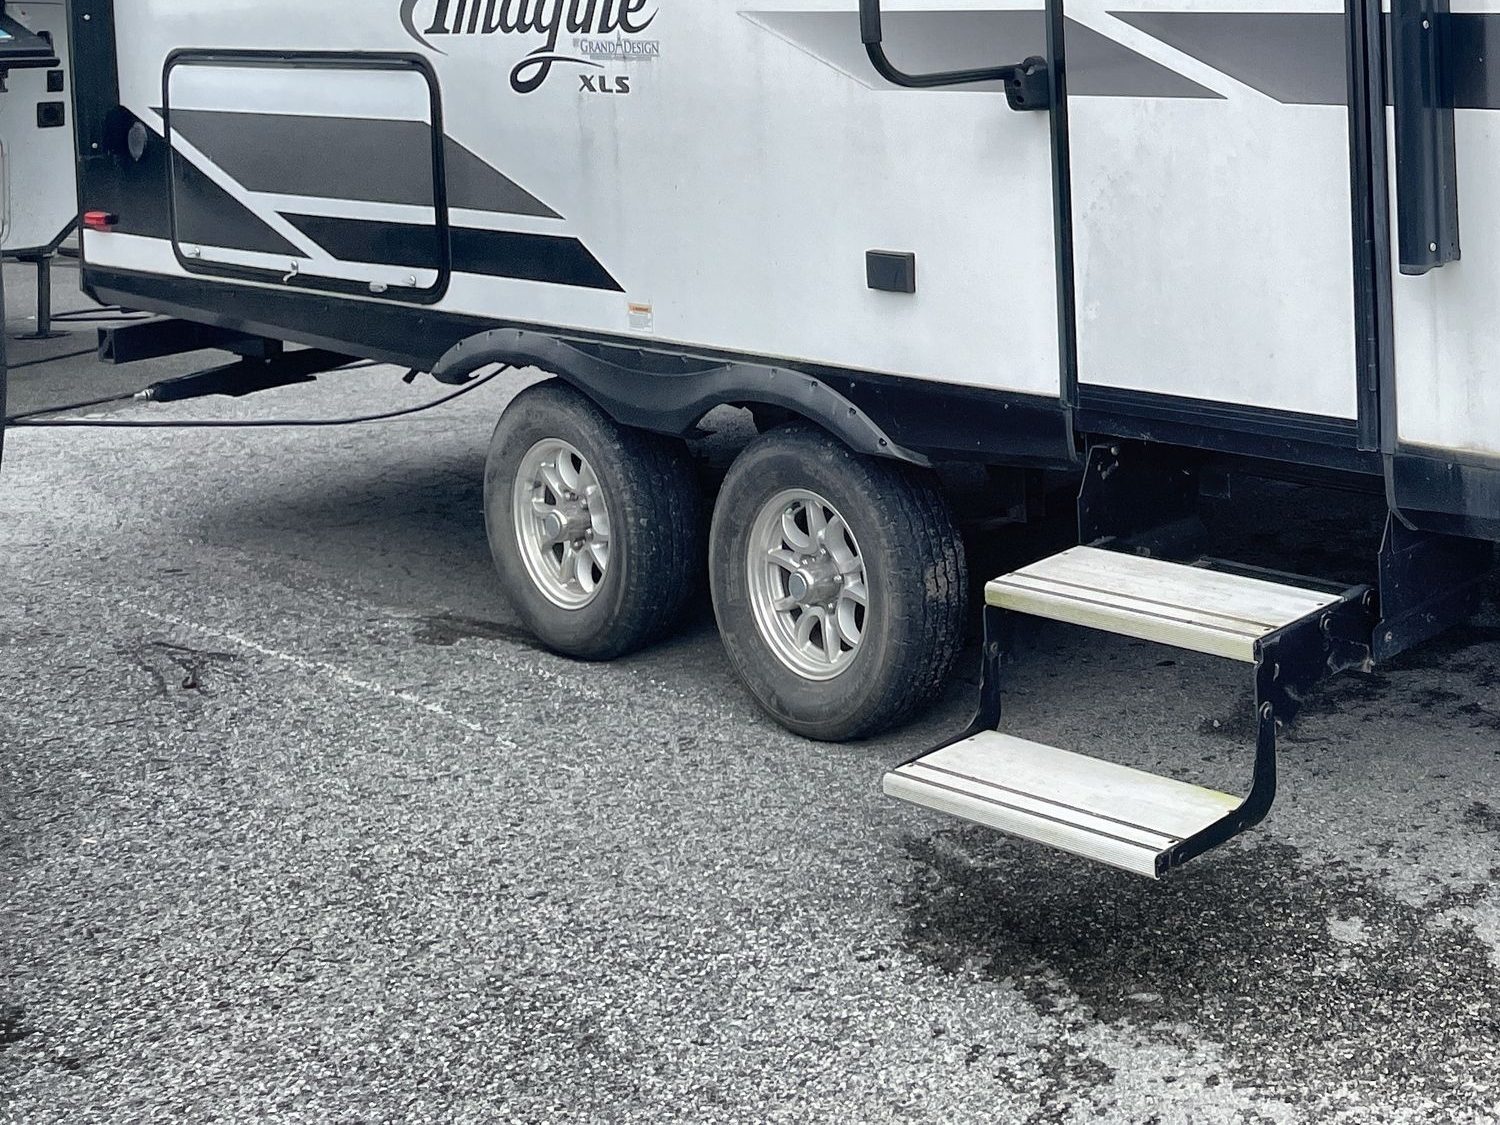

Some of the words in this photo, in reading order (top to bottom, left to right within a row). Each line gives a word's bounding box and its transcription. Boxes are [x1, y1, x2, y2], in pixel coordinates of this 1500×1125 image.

[580, 39, 615, 54] GRAND
[623, 40, 660, 56] DESIGN
[578, 74, 631, 94] XLS
